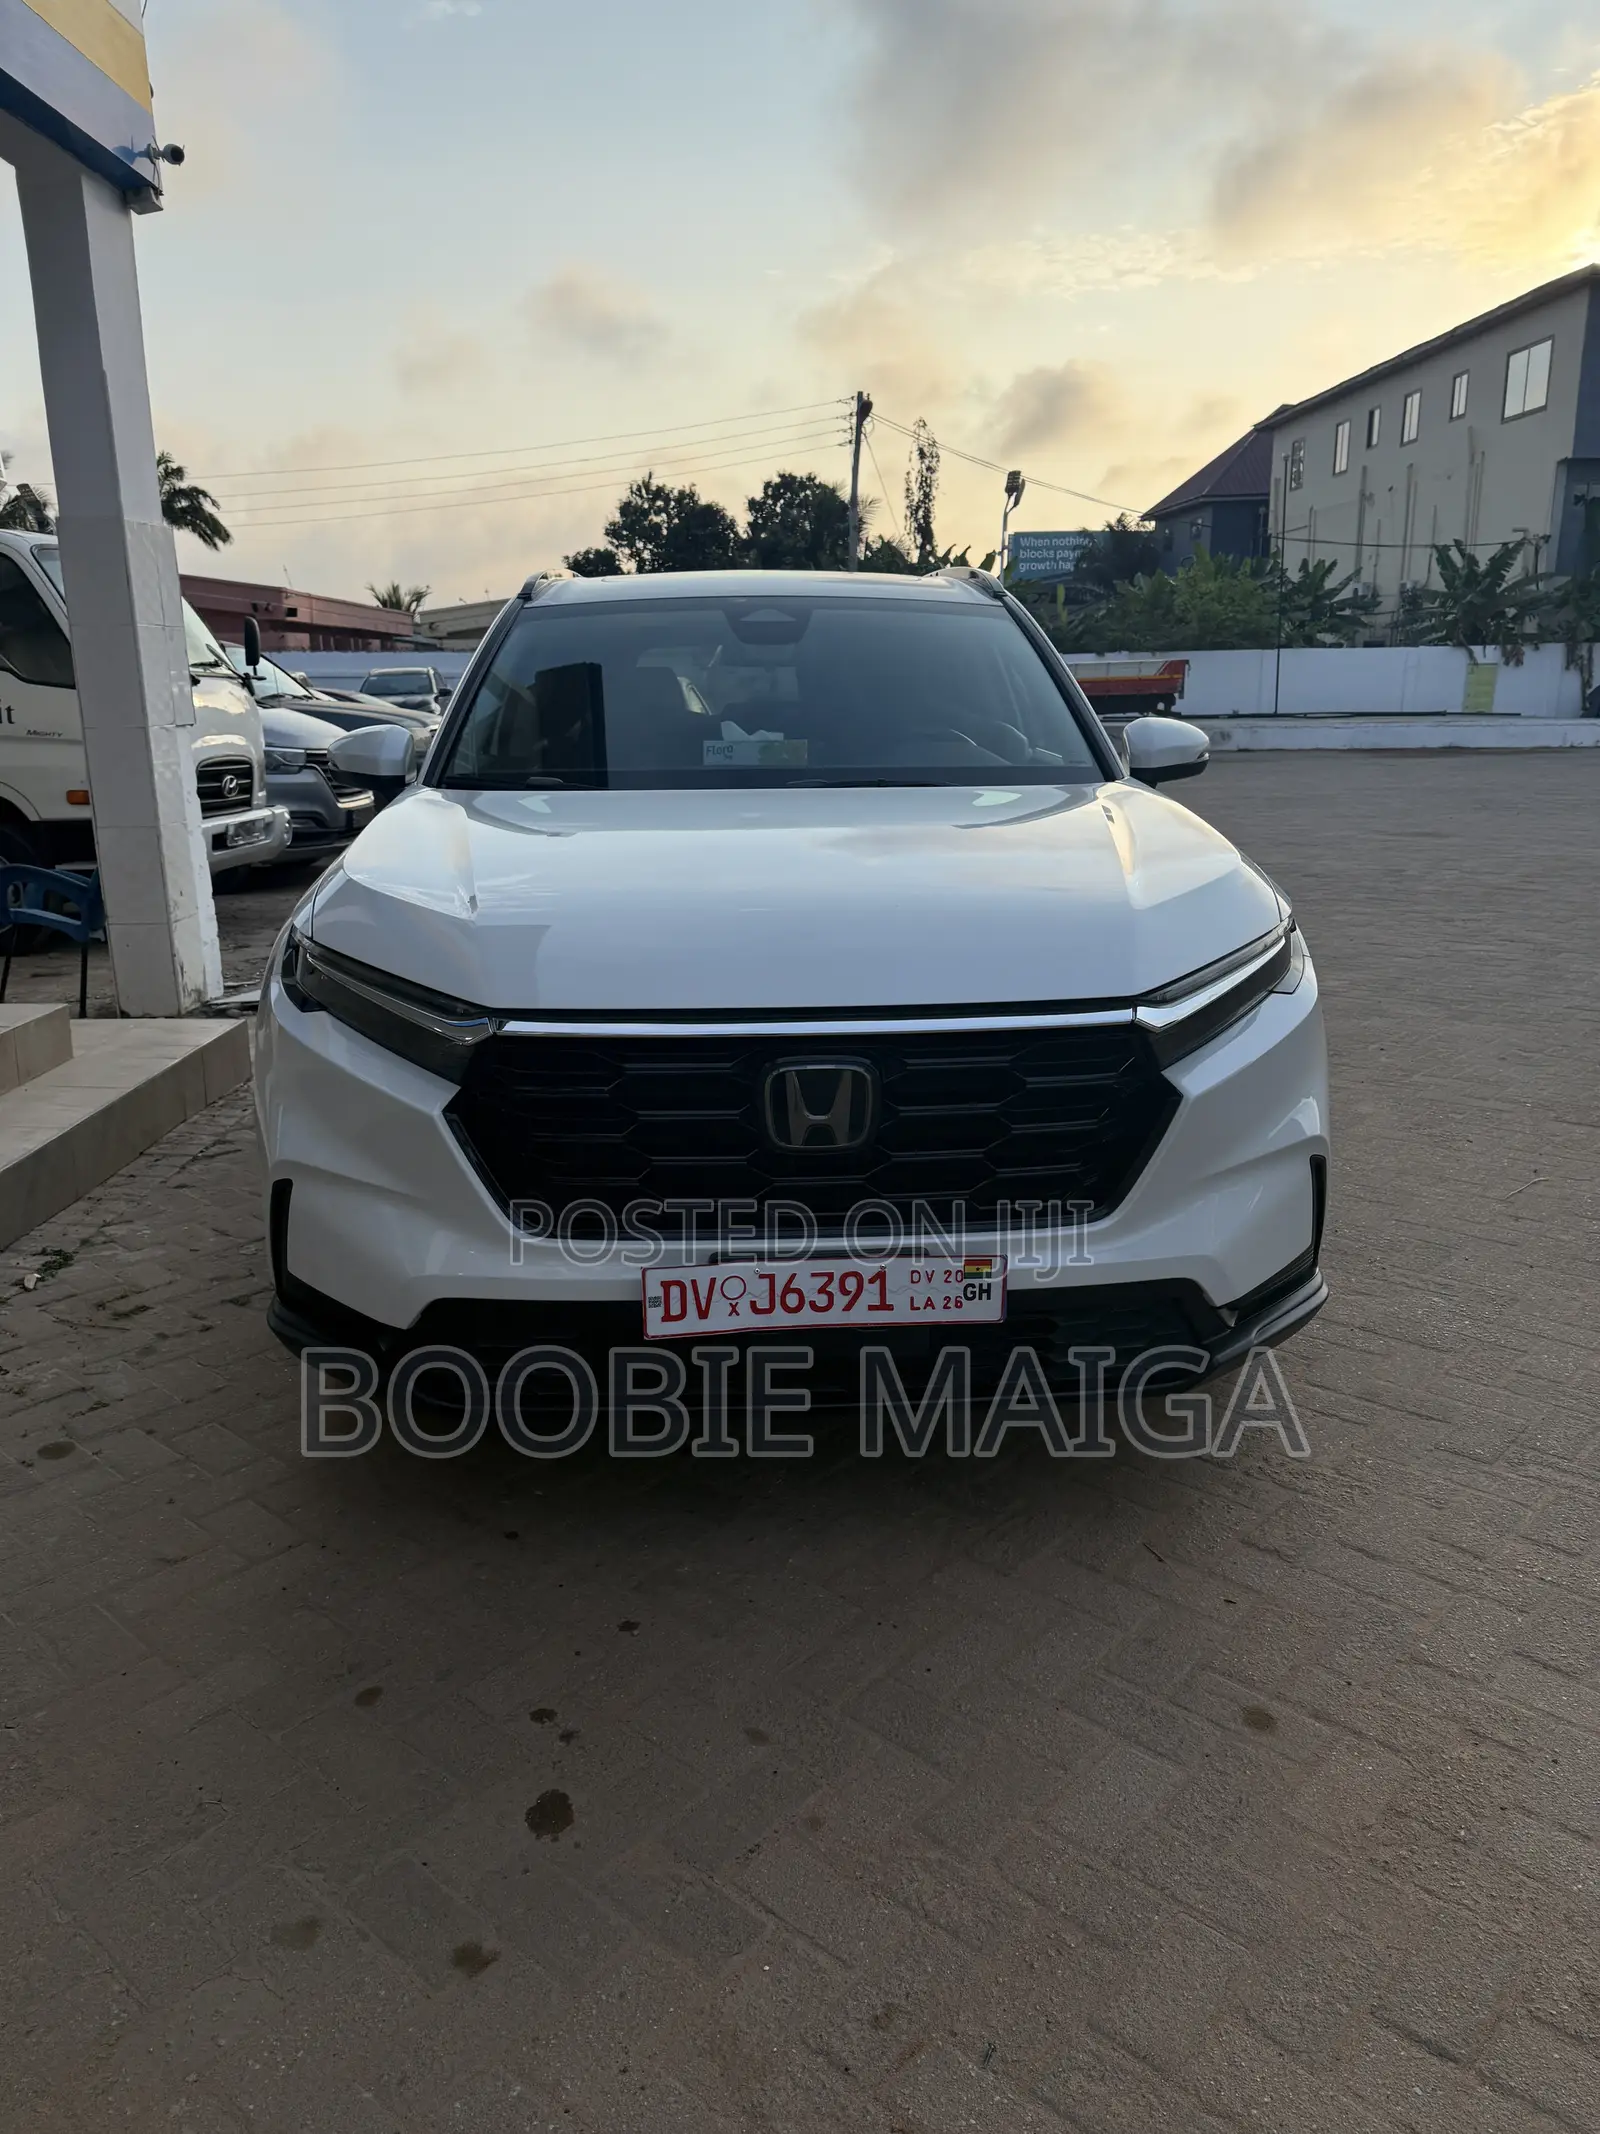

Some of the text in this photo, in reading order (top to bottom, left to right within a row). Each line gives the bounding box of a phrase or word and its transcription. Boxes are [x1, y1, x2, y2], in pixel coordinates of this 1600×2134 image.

[1020, 537, 1050, 547] When
[1019, 548, 1055, 559] blocks
[1019, 561, 1057, 573] growth
[910, 1269, 964, 1284] DV 20
[660, 1278, 717, 1322] DV
[750, 1270, 894, 1315] J6391
[963, 1283, 992, 1302] GH
[909, 1295, 964, 1311] LA 26
